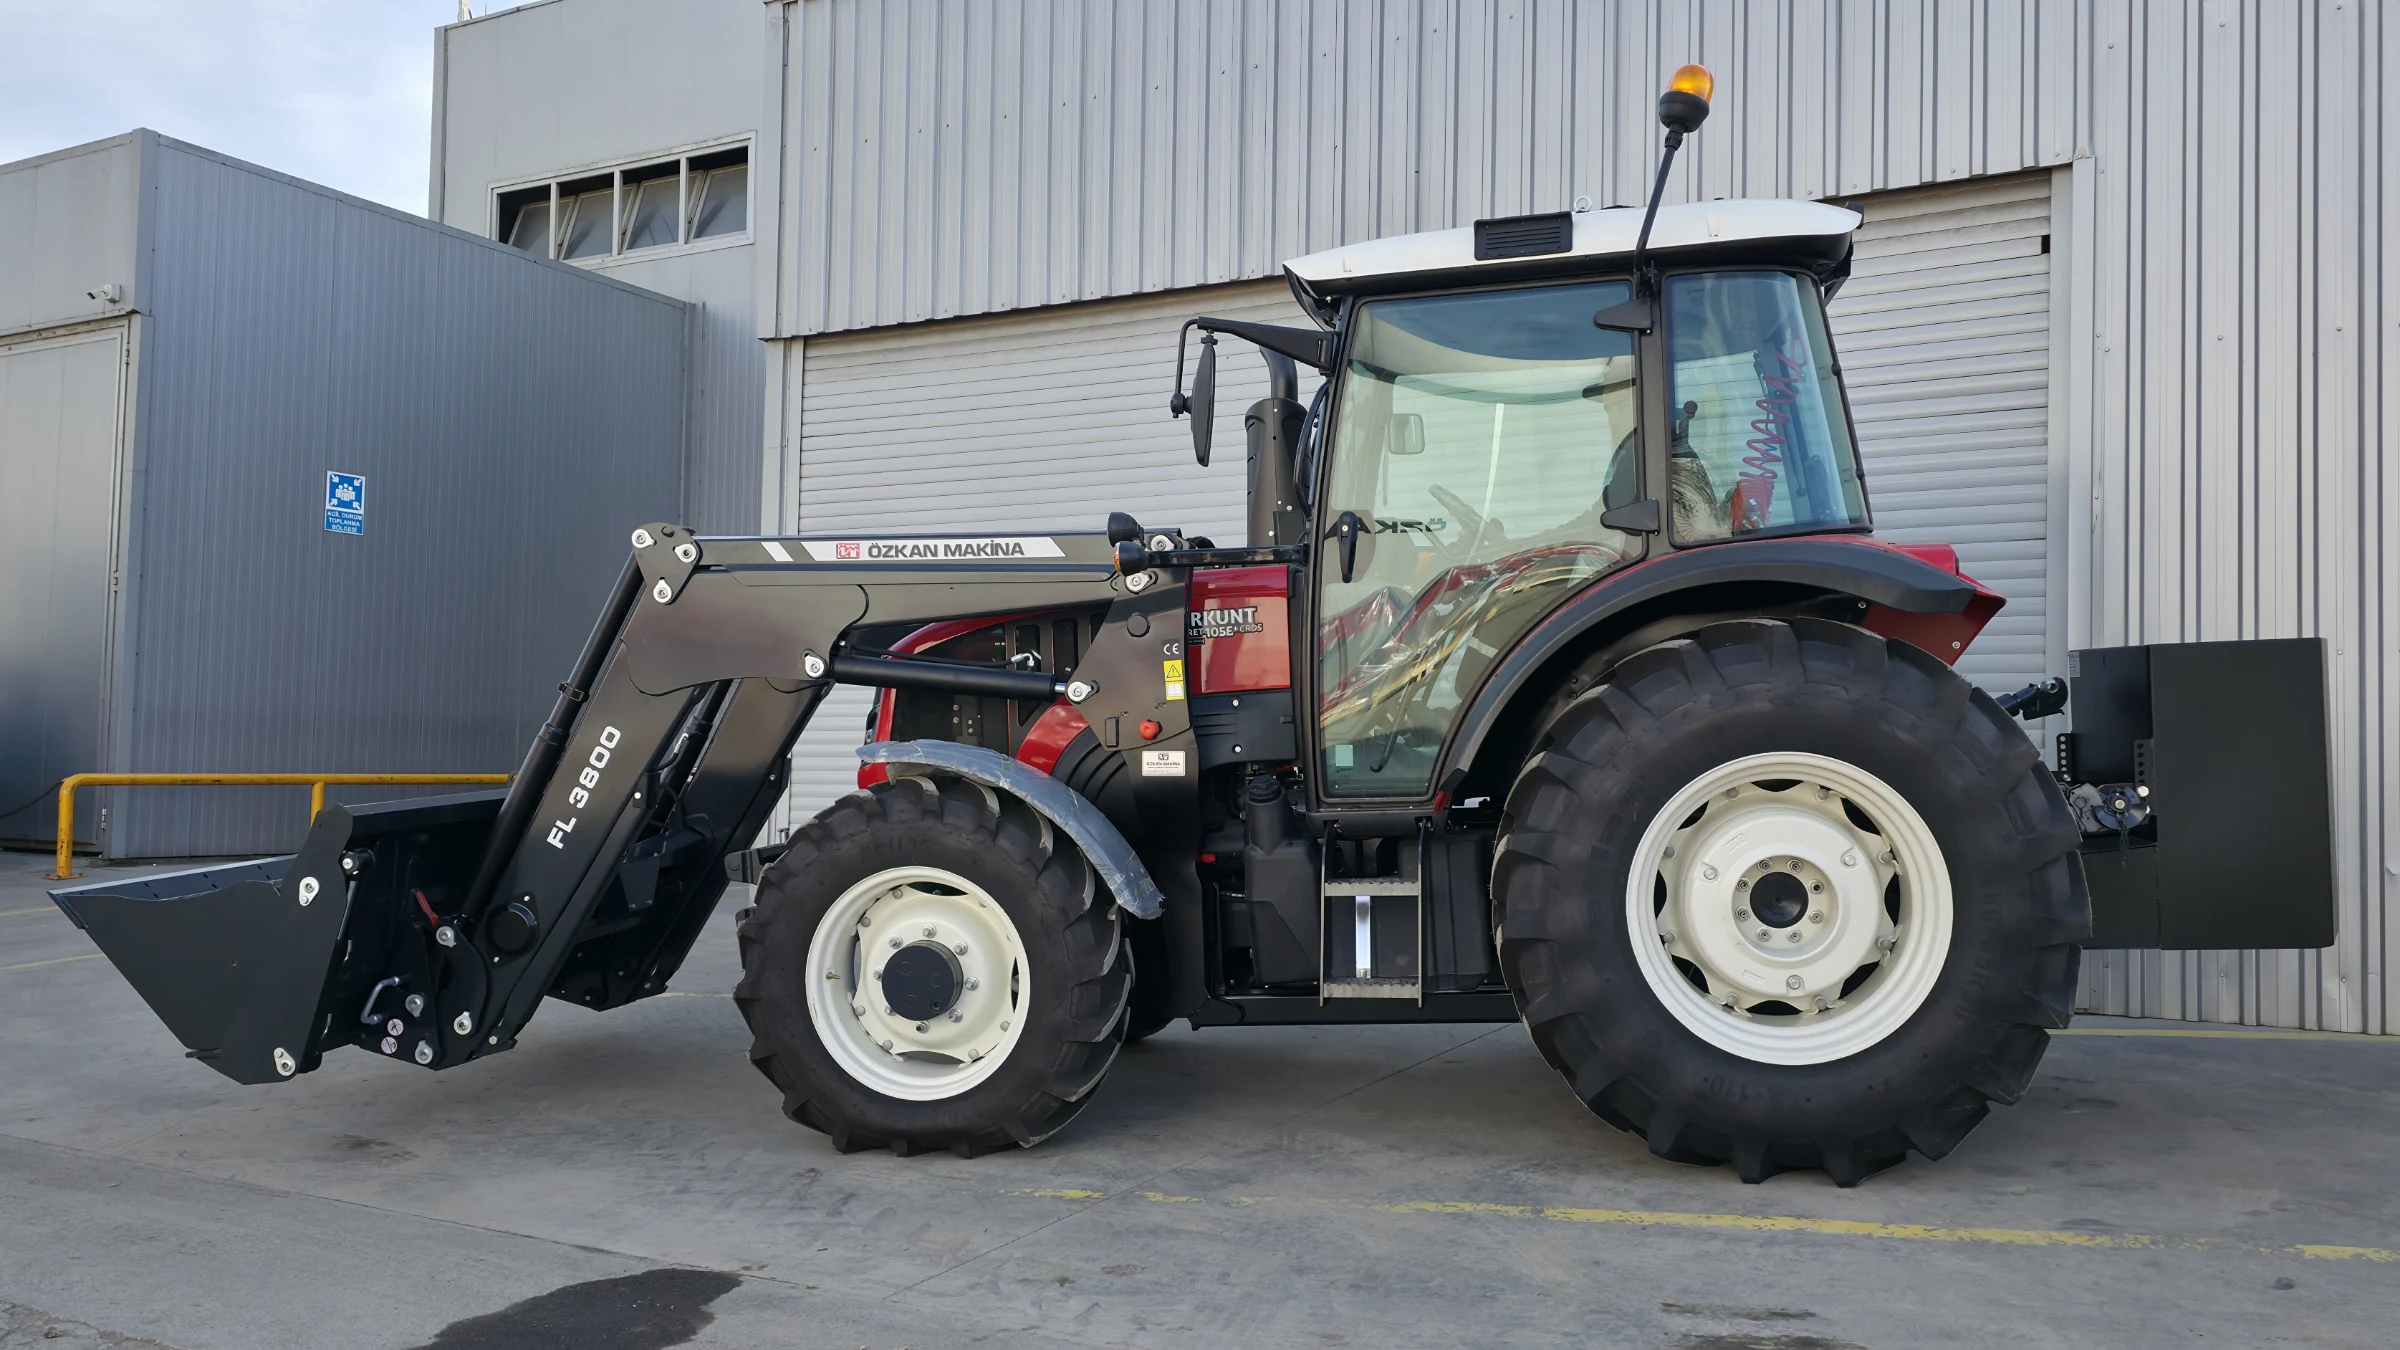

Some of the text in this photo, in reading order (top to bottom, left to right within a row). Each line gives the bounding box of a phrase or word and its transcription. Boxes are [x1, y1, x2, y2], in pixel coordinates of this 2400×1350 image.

[329, 517, 360, 526] TOPLANMA
[868, 542, 938, 558] ÖZKAN
[943, 540, 1025, 558] MAKİNA
[1190, 607, 1257, 627] RKUNT
[1163, 643, 1179, 655] CE
[546, 725, 621, 850] FL 3800
